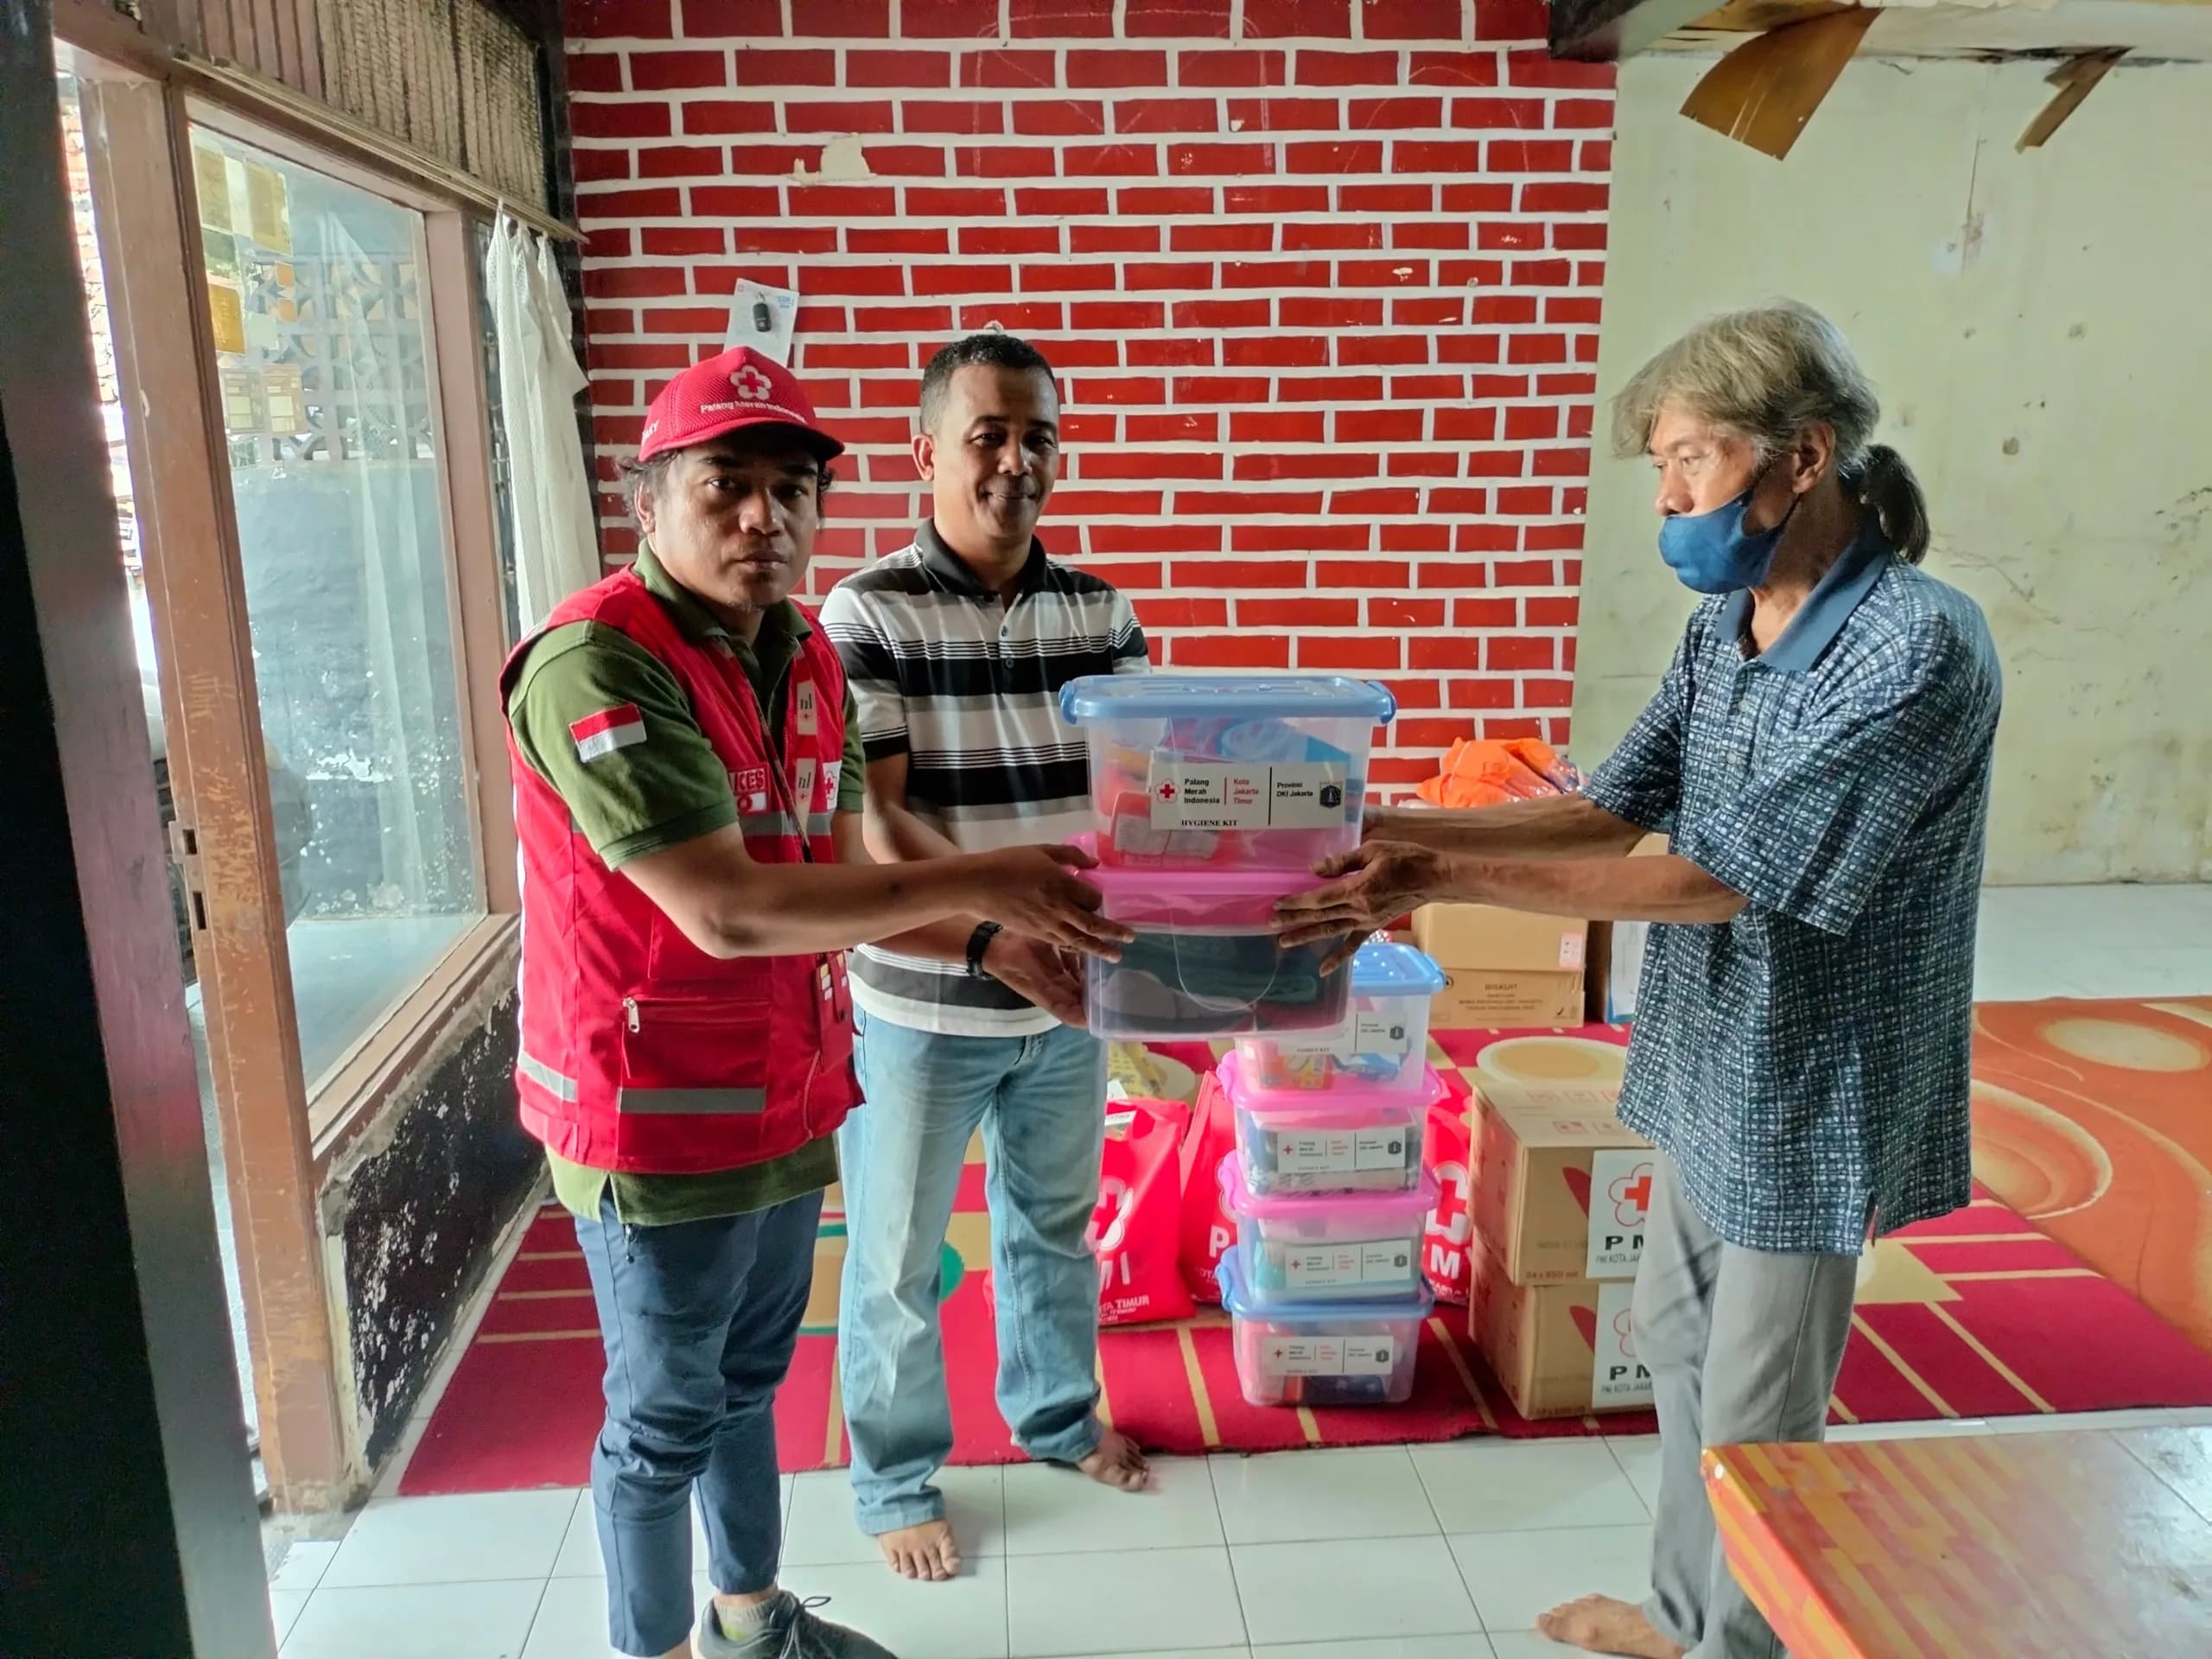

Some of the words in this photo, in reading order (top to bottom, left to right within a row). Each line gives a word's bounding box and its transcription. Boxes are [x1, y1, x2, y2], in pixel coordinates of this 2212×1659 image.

[734, 769, 766, 790] KES
[1184, 778, 1210, 787] Palang
[1115, 1294, 1150, 1311] TIMUR
